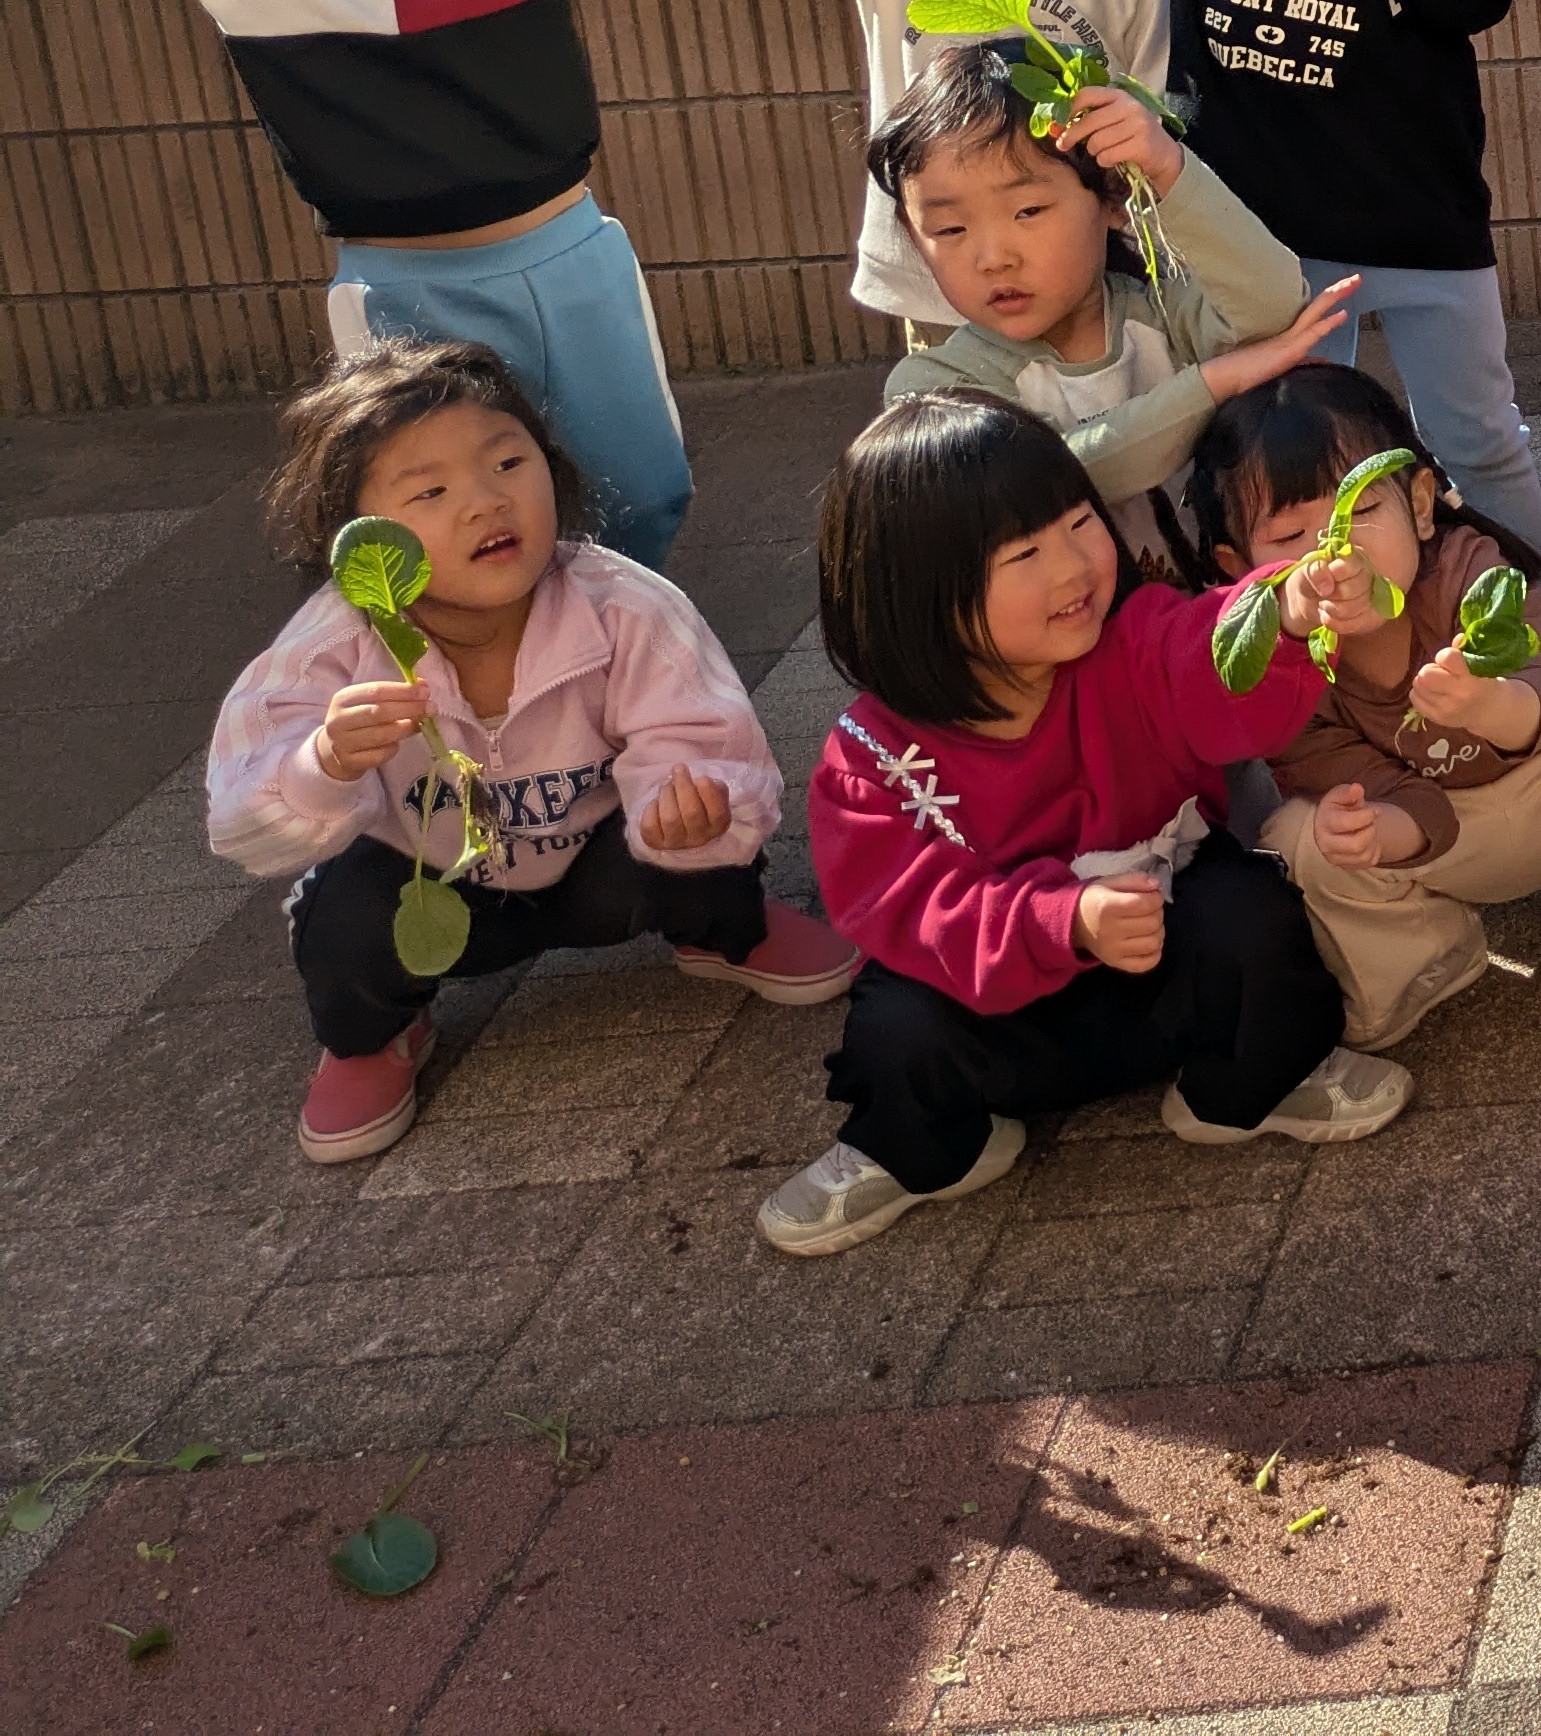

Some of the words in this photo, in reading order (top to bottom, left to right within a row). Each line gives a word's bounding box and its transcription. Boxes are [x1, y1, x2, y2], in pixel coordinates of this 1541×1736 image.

[1204, 7, 1232, 33] 227
[1309, 36, 1345, 58] 745
[1207, 38, 1334, 88] QUEBEC.CA
